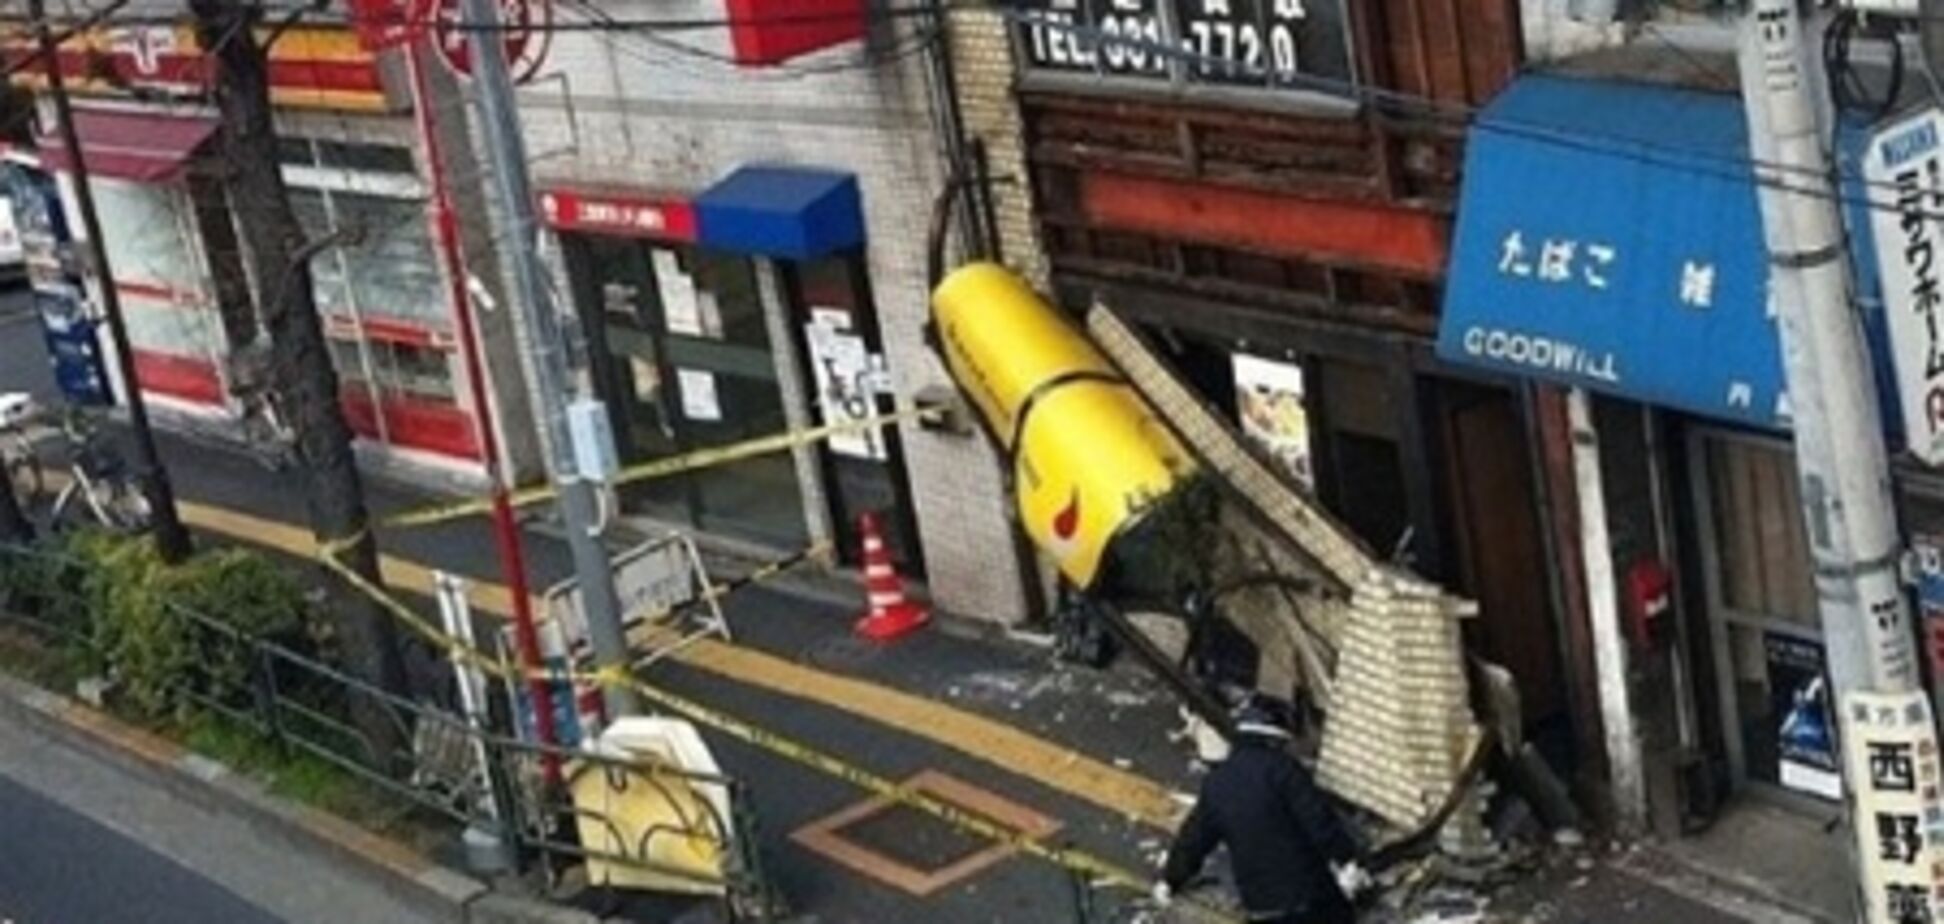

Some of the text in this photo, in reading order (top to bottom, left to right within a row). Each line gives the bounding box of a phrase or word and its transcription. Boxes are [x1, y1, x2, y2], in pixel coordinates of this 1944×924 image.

[1498, 230, 1616, 290] たばこ
[1463, 325, 1619, 382] GOODWILL
